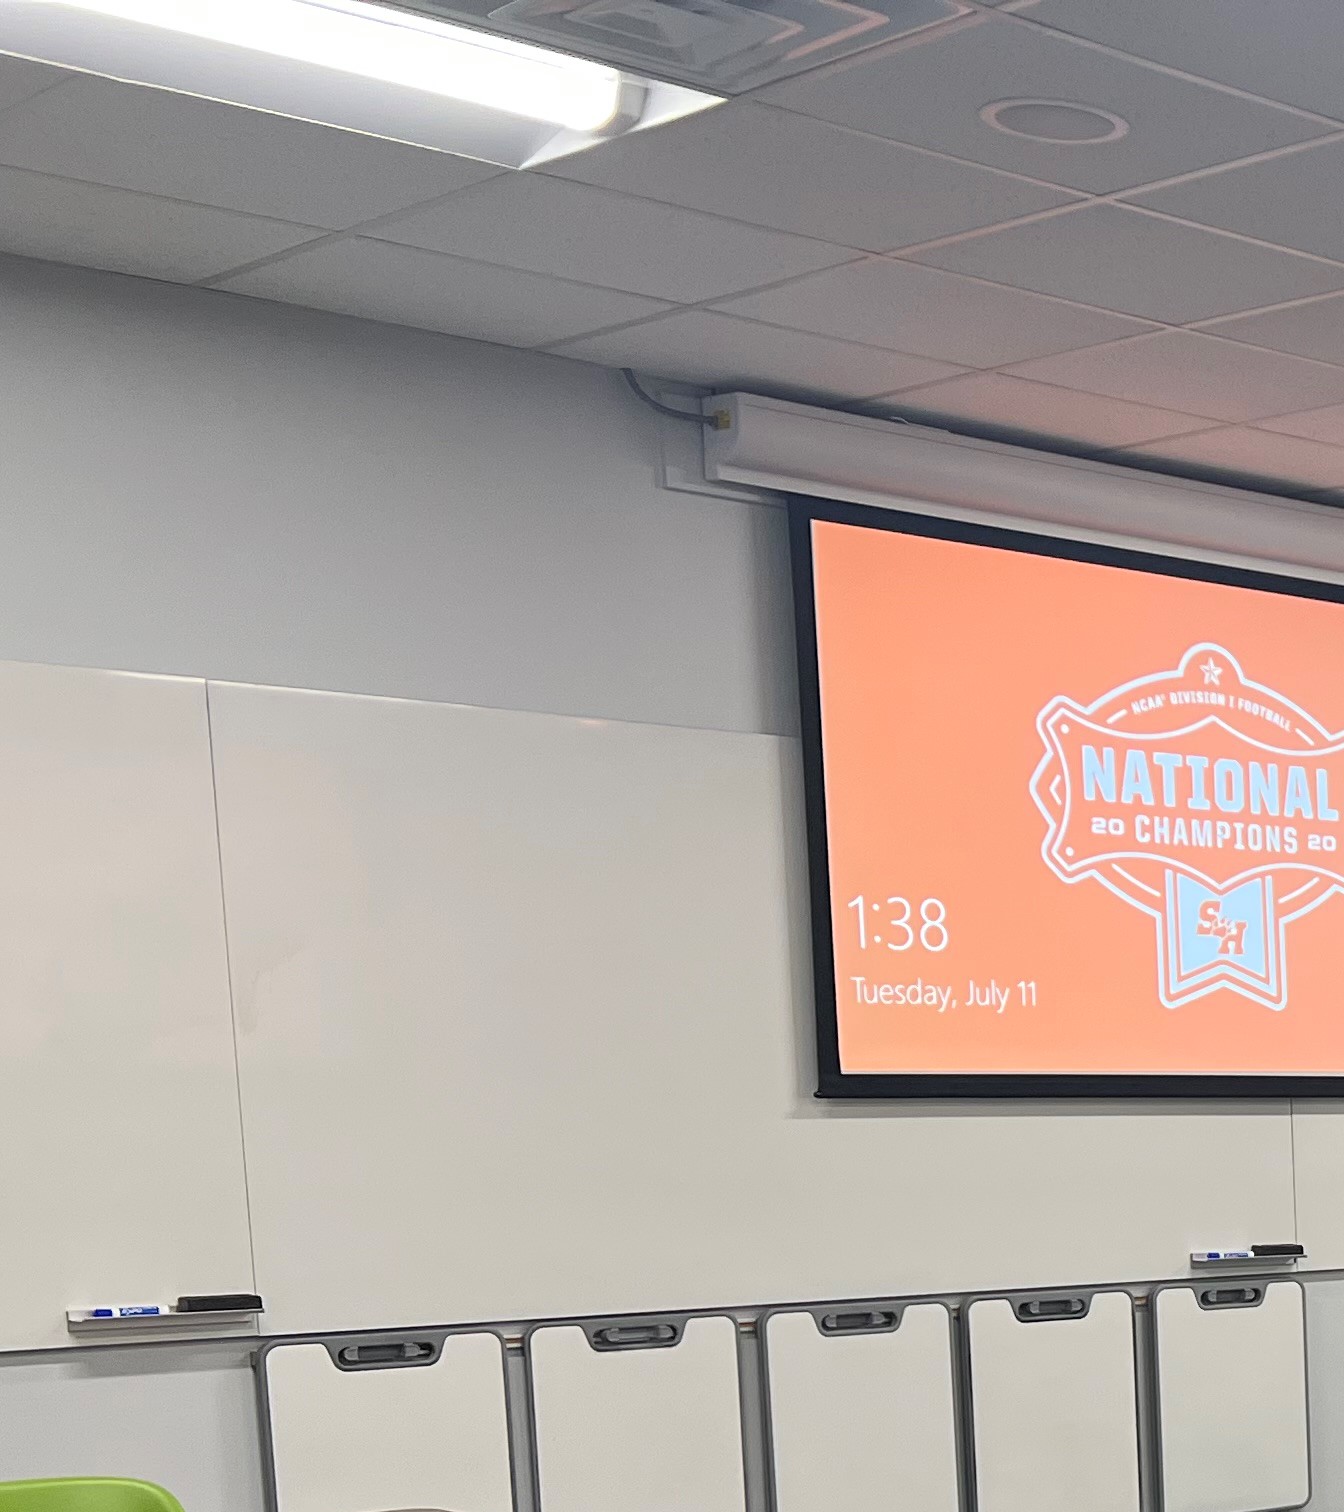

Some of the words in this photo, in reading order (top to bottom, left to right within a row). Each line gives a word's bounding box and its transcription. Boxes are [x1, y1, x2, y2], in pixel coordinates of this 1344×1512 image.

[1169, 690, 1226, 706] DIVISION
[1229, 695, 1235, 709] I
[1238, 697, 1292, 732] FOOTBALL
[1081, 744, 1340, 822] NATIONAL
[1091, 816, 1125, 835] 20
[1134, 814, 1298, 854] CHAMPIONS
[1307, 833, 1337, 852] 20
[847, 894, 949, 952] 1:38
[849, 976, 957, 1013] Tuesday,
[965, 979, 1010, 1014] July
[1017, 981, 1037, 1007] 11
